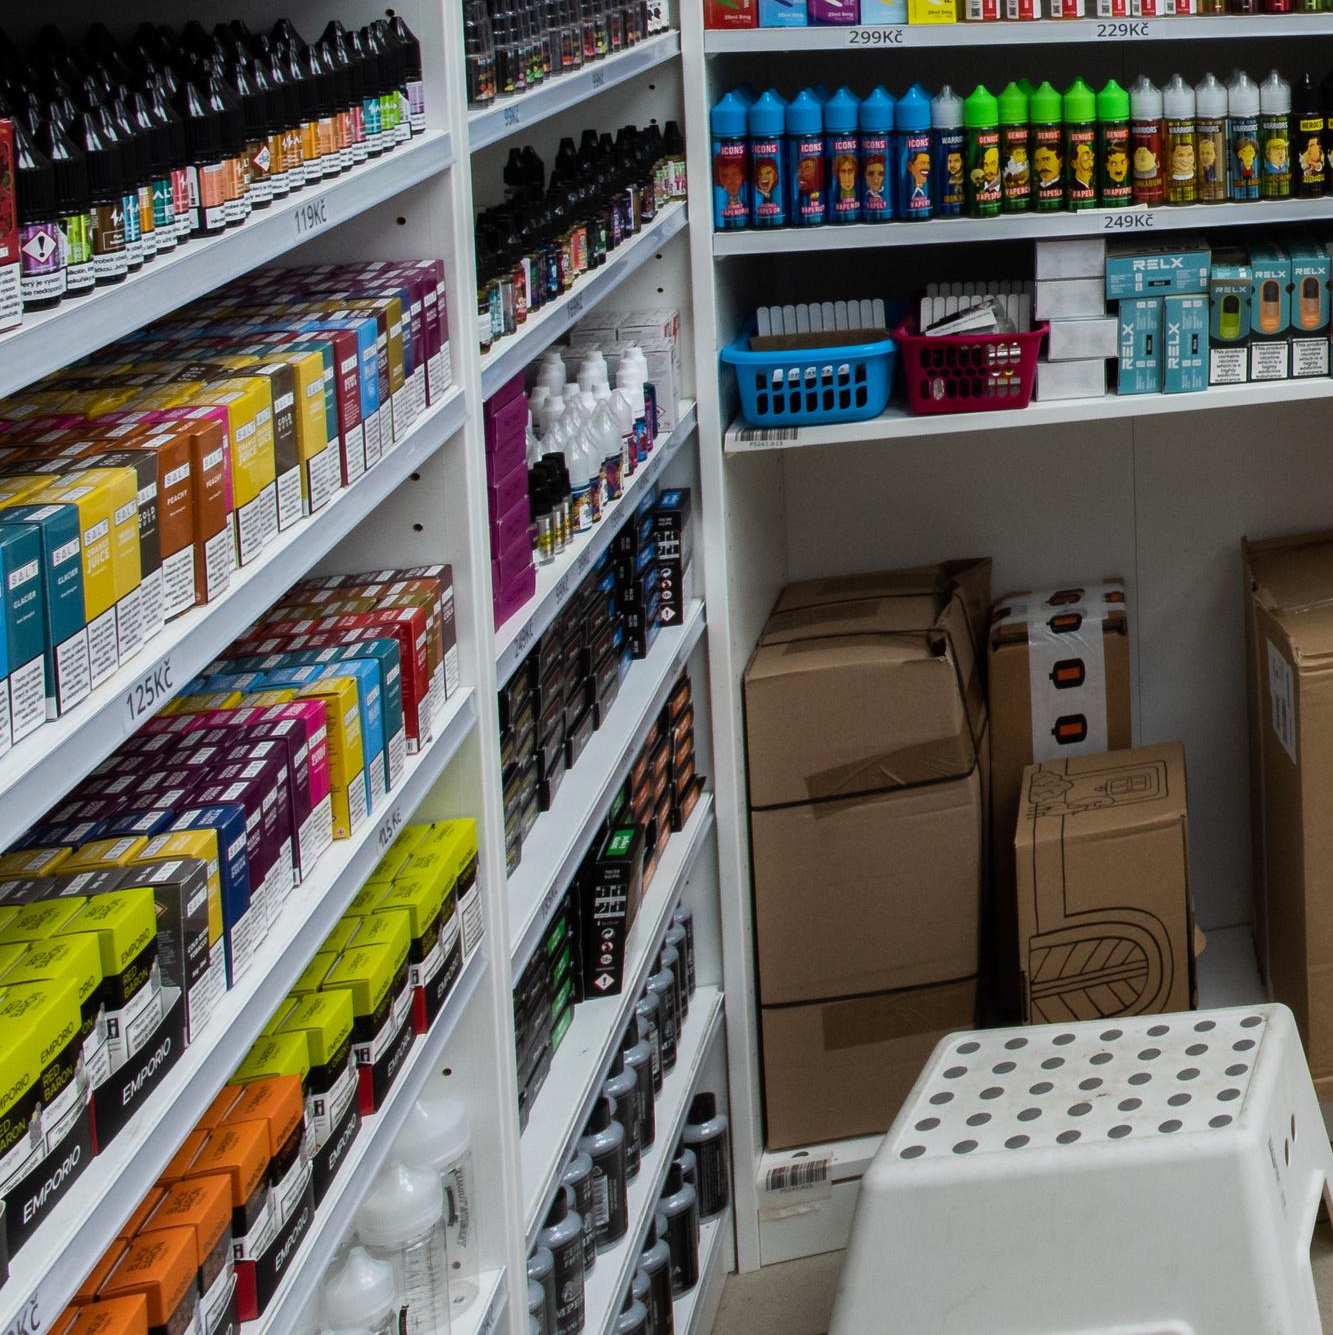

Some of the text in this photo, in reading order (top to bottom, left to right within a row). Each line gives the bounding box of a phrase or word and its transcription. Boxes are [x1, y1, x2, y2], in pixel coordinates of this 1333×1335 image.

[849, 29, 903, 45] 299Kč
[1096, 22, 1149, 37] 229Kč
[721, 145, 744, 155] ICONS
[801, 142, 822, 153] ICONS
[294, 198, 327, 232] 119Kč
[1104, 213, 1153, 229] 249Kč
[1133, 257, 1184, 271] RELX
[1295, 267, 1325, 275] RELX
[1255, 270, 1286, 278] RELX
[1215, 285, 1247, 293] RELX
[1122, 323, 1134, 370] RELX
[1168, 322, 1180, 370] RELX
[205, 473, 222, 488] PEACHY
[167, 489, 188, 506] PEACHY
[57, 567, 78, 585] GLACIER
[13, 590, 36, 609] GLACIER
[126, 657, 173, 721] 125Kč
[121, 927, 151, 965] EMPORIO
[40, 1022, 74, 1064] EMPORIO
[42, 1064, 61, 1088] RED
[122, 1038, 171, 1106] EMPORIO
[44, 1064, 73, 1102] BARON
[22, 1145, 82, 1225] EMPORIO
[274, 1212, 309, 1272] EMPORIO
